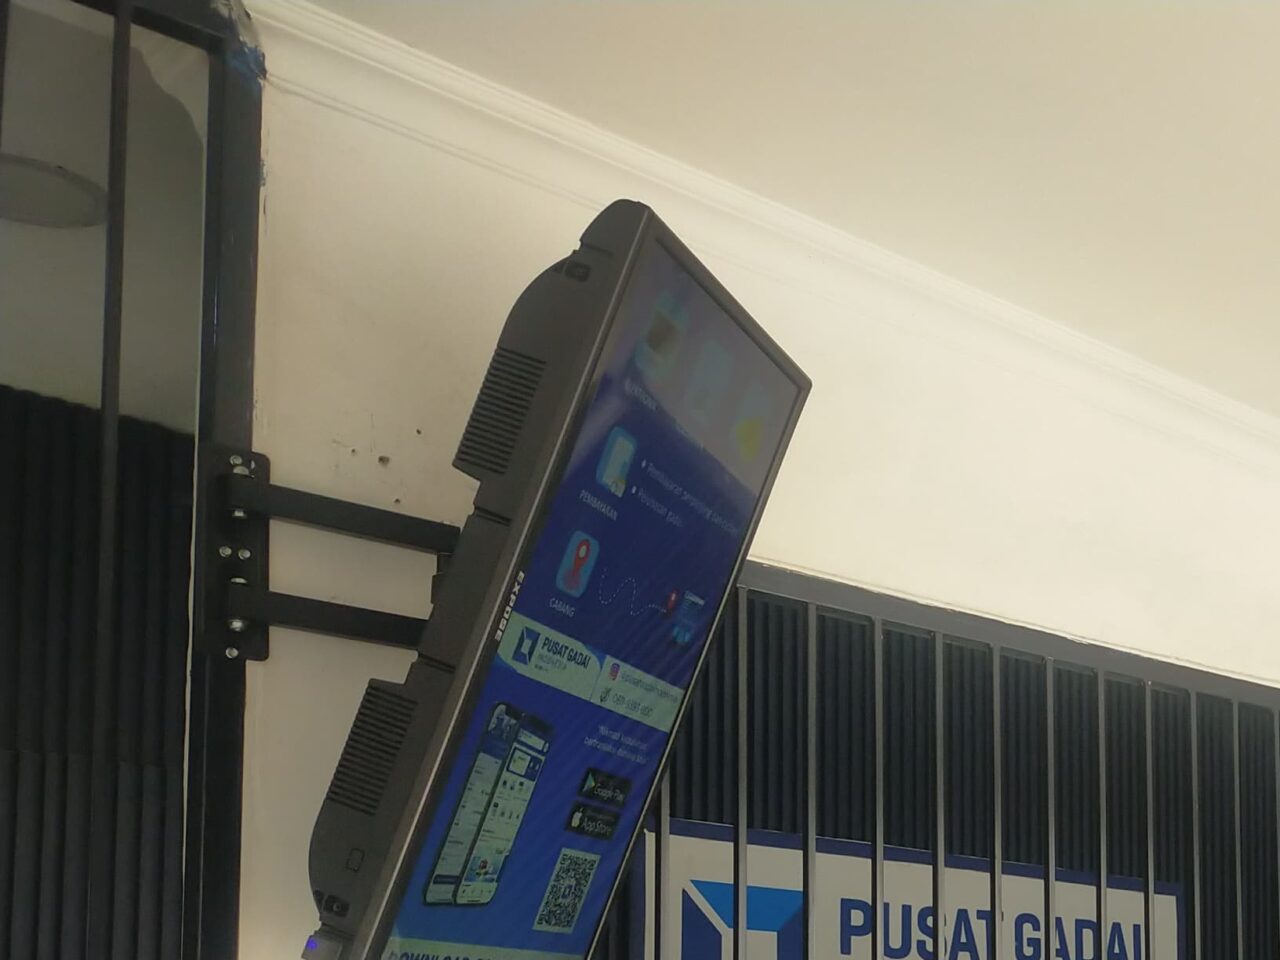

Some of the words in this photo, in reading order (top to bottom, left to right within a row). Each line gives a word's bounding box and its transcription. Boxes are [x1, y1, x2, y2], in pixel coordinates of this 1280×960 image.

[549, 597, 577, 618] CABANG
[541, 636, 570, 660] PUSAT
[567, 648, 591, 670] GADAI
